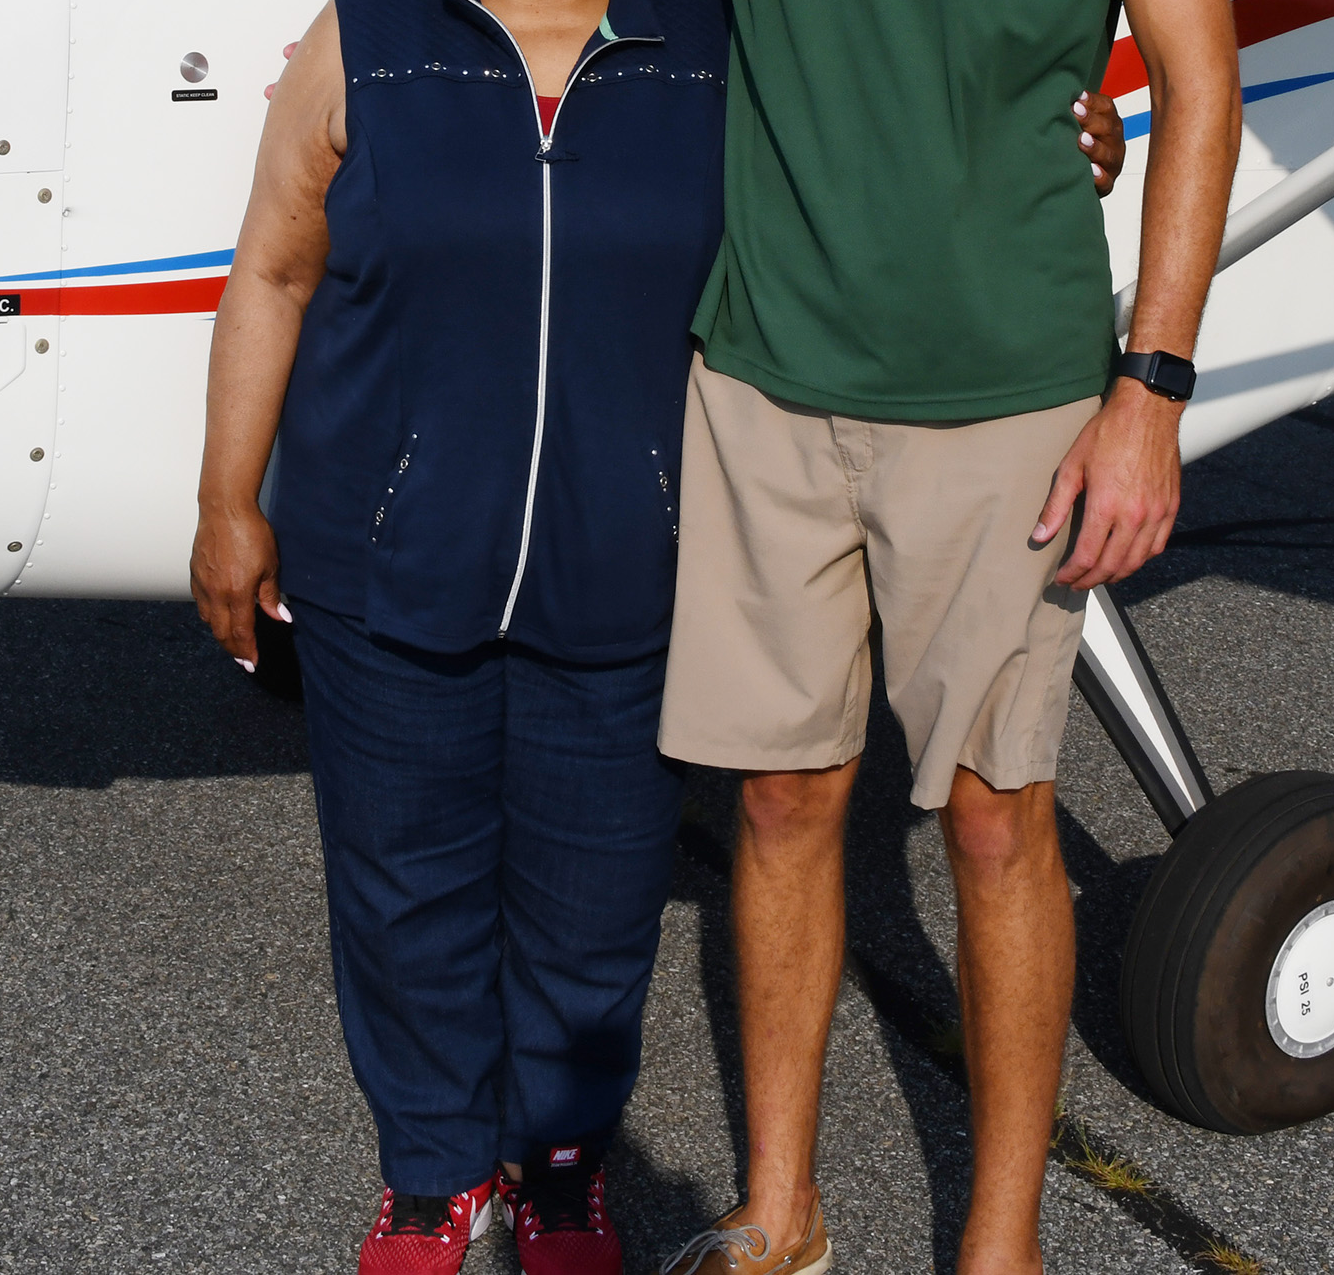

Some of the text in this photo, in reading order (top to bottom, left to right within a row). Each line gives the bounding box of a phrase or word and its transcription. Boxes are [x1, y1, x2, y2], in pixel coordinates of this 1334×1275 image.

[1298, 971, 1311, 1016] PSI 25
[552, 1148, 578, 1161] NIKE
